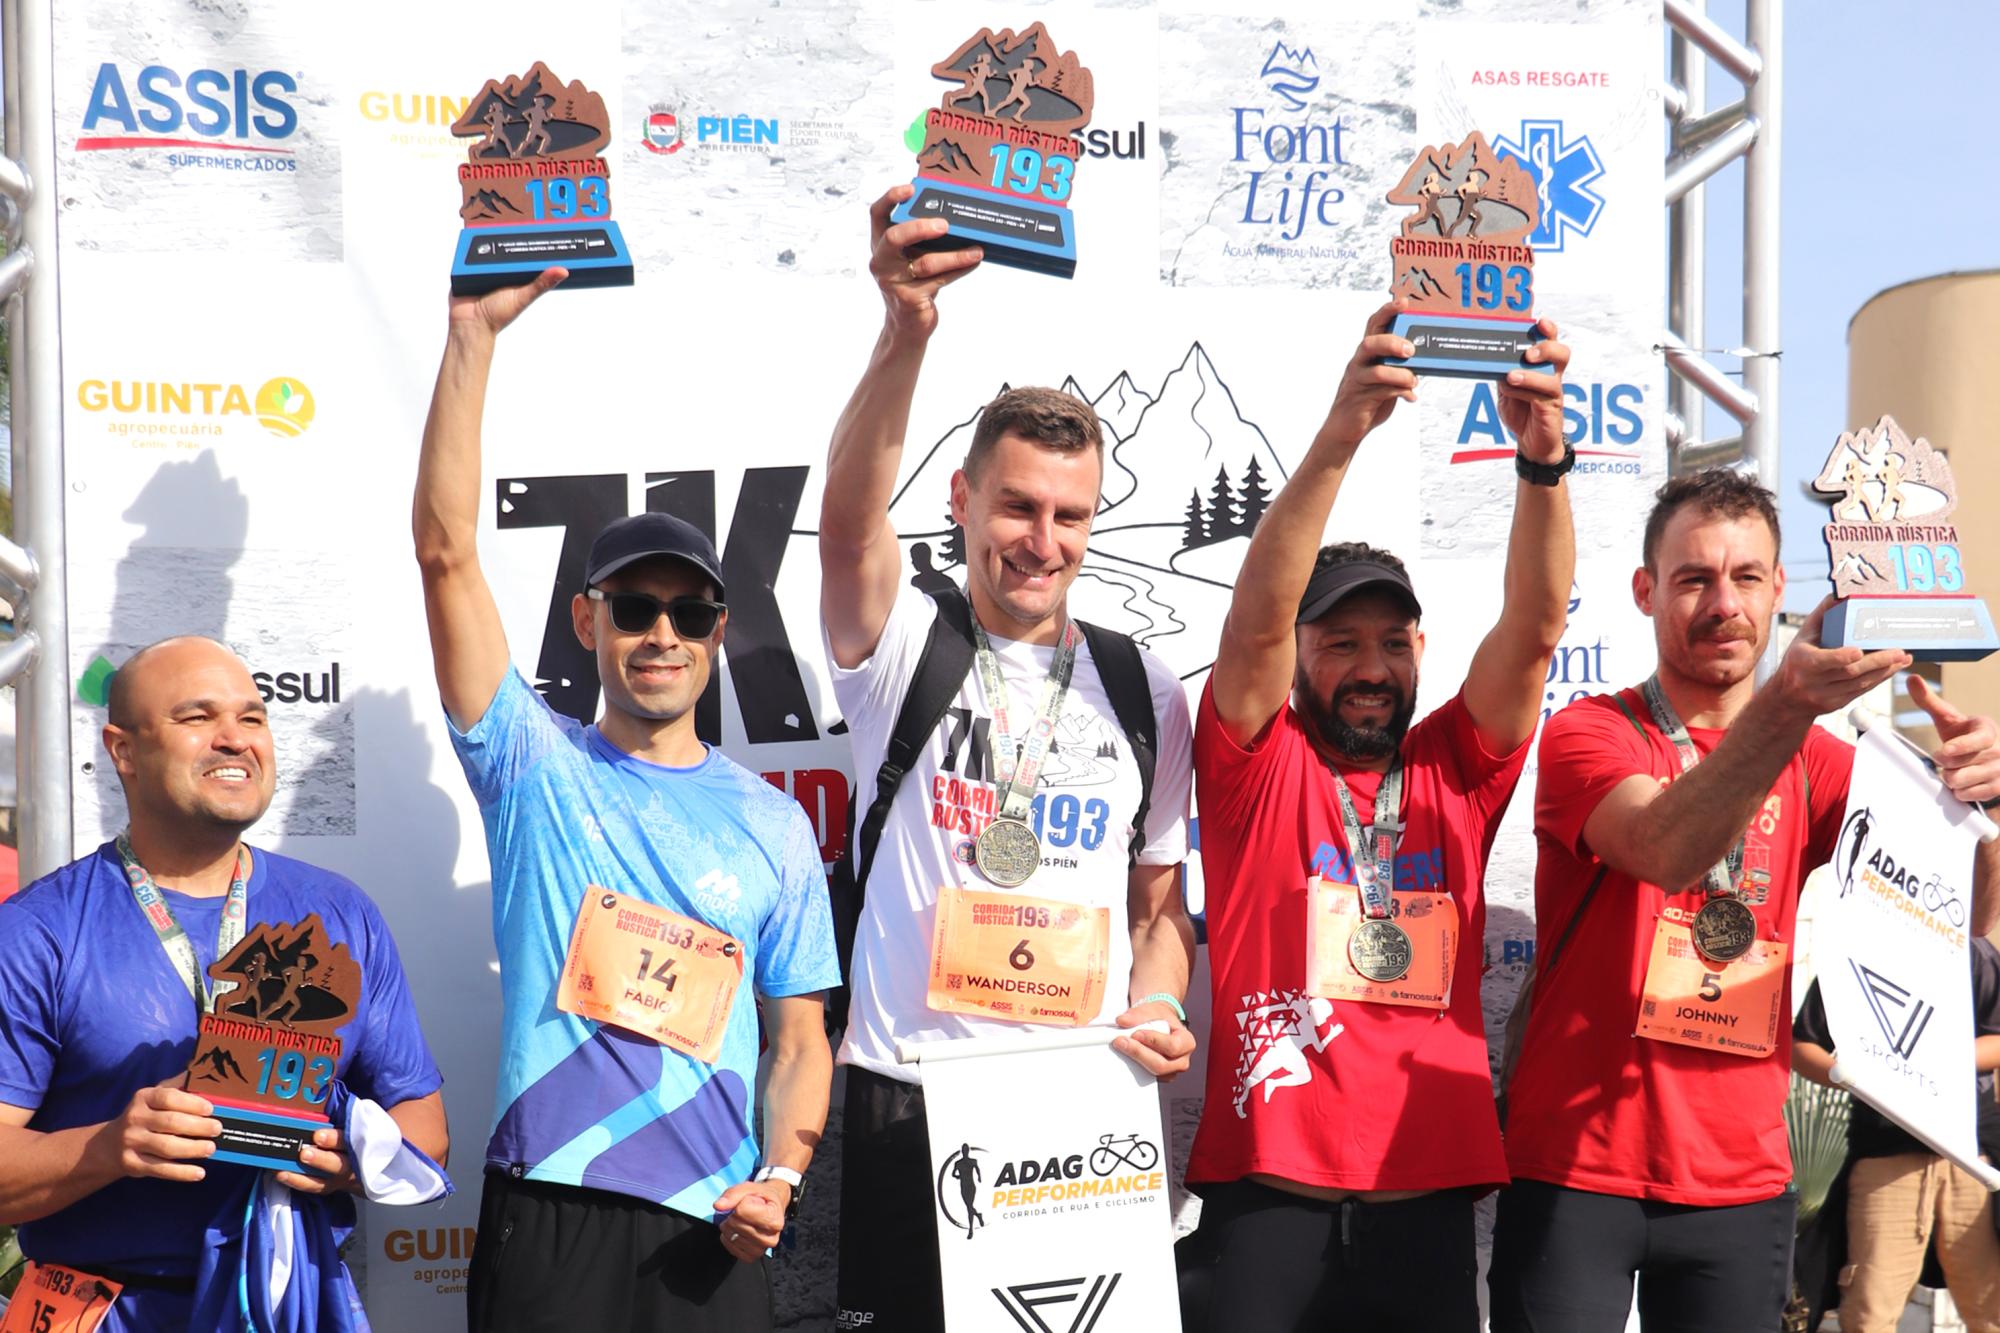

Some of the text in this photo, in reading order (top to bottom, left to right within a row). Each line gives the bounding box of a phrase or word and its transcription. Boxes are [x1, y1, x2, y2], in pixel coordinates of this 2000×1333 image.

[1472, 71, 1610, 88] ASAS RESGATE
[82, 63, 298, 139] ASSIS
[359, 90, 470, 126] GUIN
[698, 113, 778, 145] PIÊN
[928, 108, 1004, 141] CORRIDA
[1230, 107, 1350, 165] Font
[700, 143, 771, 154] PREFEITURA
[168, 153, 297, 173] SUPERMERCADOS
[458, 162, 534, 180] CORRIDA
[989, 143, 1075, 201] 193
[525, 175, 610, 221] 193
[1238, 171, 1344, 241] Life
[1309, 245, 1359, 260] NATURAL
[1394, 238, 1464, 260] CORRIDA
[1455, 262, 1532, 312] 193
[78, 379, 252, 416] GUINTA
[1457, 383, 1643, 445] ASIS
[108, 422, 223, 437] agropecuária
[1571, 462, 1641, 475] MERCADOS
[1828, 524, 1894, 543] CORRIDA
[1887, 544, 1964, 592] 193
[1031, 793, 1110, 852] 193
[1053, 856, 1079, 870] PIÊN
[1377, 860, 1391, 880] 193
[1867, 848, 1920, 899] ADAG
[135, 885, 155, 906] 193
[973, 903, 1016, 915] CORRIDA
[1364, 884, 1381, 907] 193
[1860, 868, 1966, 949] PERFORMANCE
[617, 908, 660, 929] CORRIDA
[973, 914, 1015, 926] RUSTICA
[1015, 905, 1050, 929] 193
[1663, 907, 1683, 921] 40
[616, 919, 658, 940] RUSTICA
[658, 921, 695, 950] 193
[1008, 938, 1035, 971] 6
[1385, 953, 1405, 967] 193
[637, 948, 678, 993] 14
[966, 974, 1071, 998] WANDERSON
[1698, 972, 1723, 1003] 5
[202, 1016, 272, 1044] CORRIDA
[1675, 1006, 1739, 1027] JOHNNY
[256, 1047, 335, 1104] 193
[1860, 1036, 1939, 1097] SPORTS
[993, 1154, 1084, 1188] ADAG
[992, 1172, 1164, 1208] PERFORMANCE
[1003, 1195, 1156, 1220] CORRIDA DE RUA E CICLISMO
[46, 1268, 75, 1296] 193
[414, 1268, 471, 1283] agrope
[30, 1299, 57, 1333] 15
